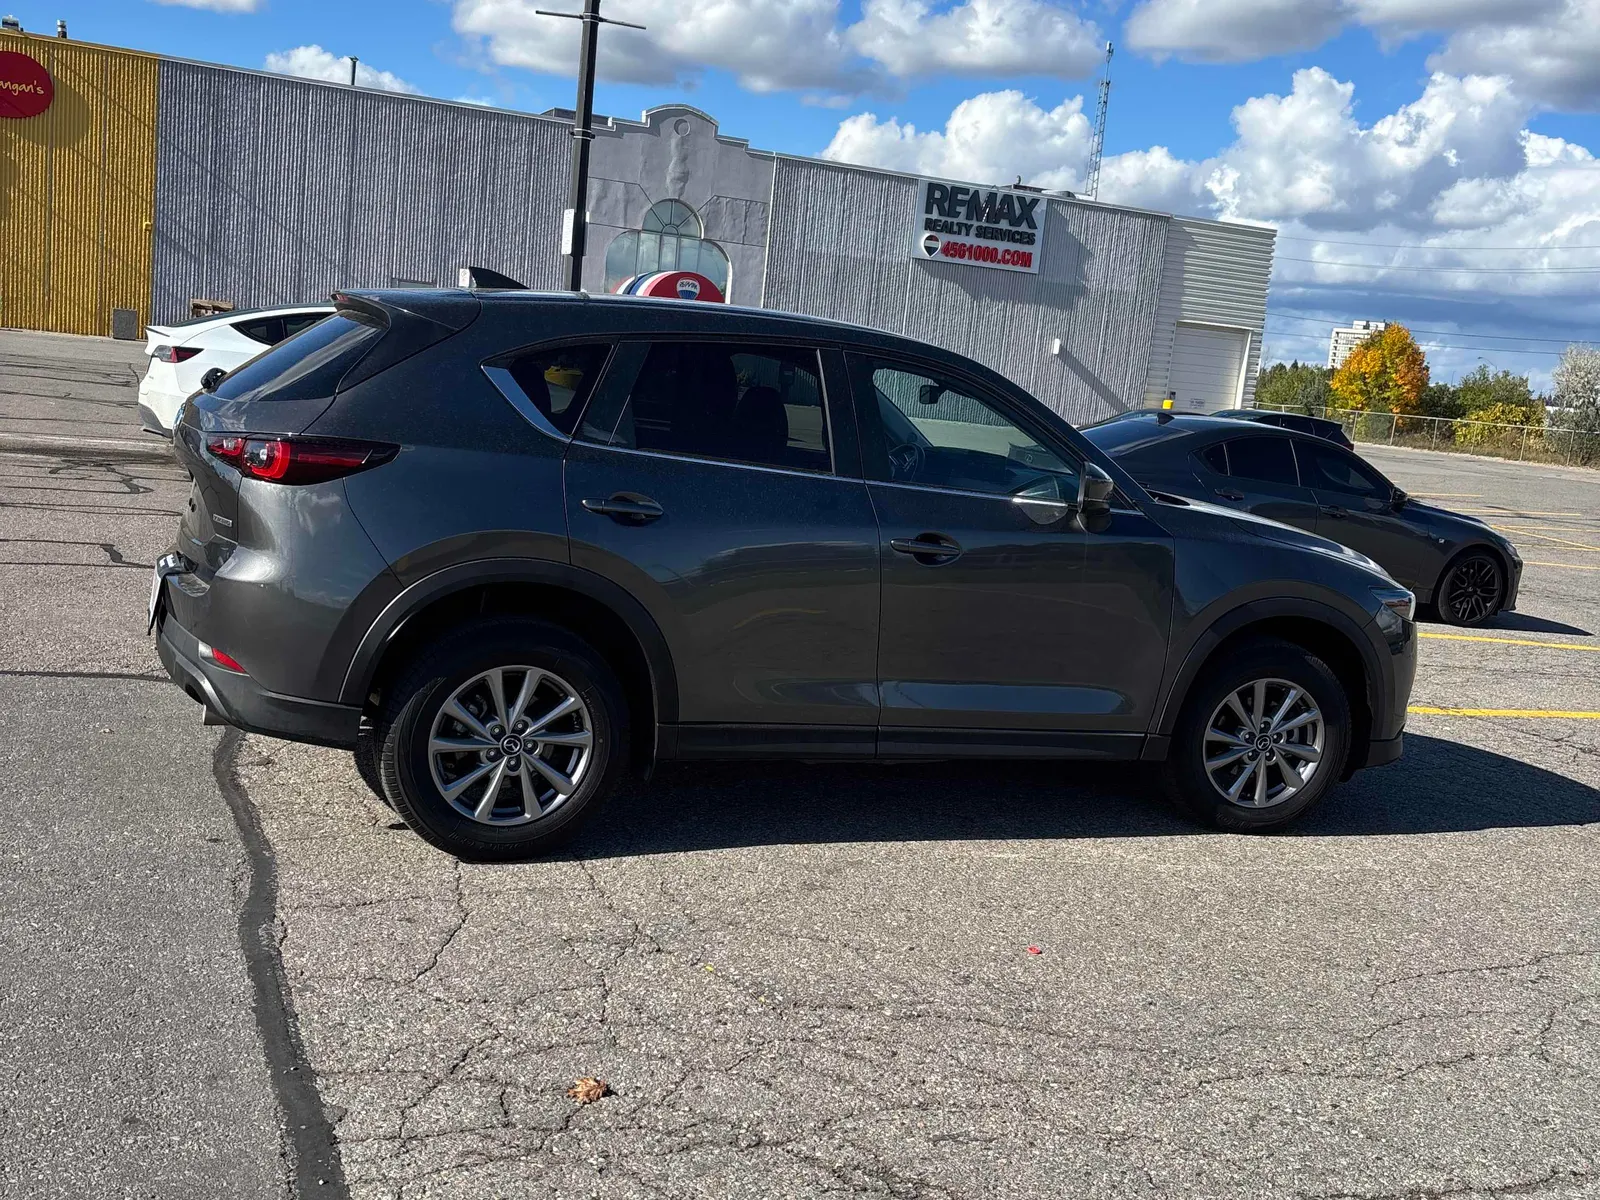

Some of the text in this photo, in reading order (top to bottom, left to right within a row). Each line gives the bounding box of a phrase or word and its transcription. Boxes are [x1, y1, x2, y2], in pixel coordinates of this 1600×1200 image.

[924, 218, 1035, 246] REALTY SERVICES
[941, 240, 1033, 268] 4561000.COM
